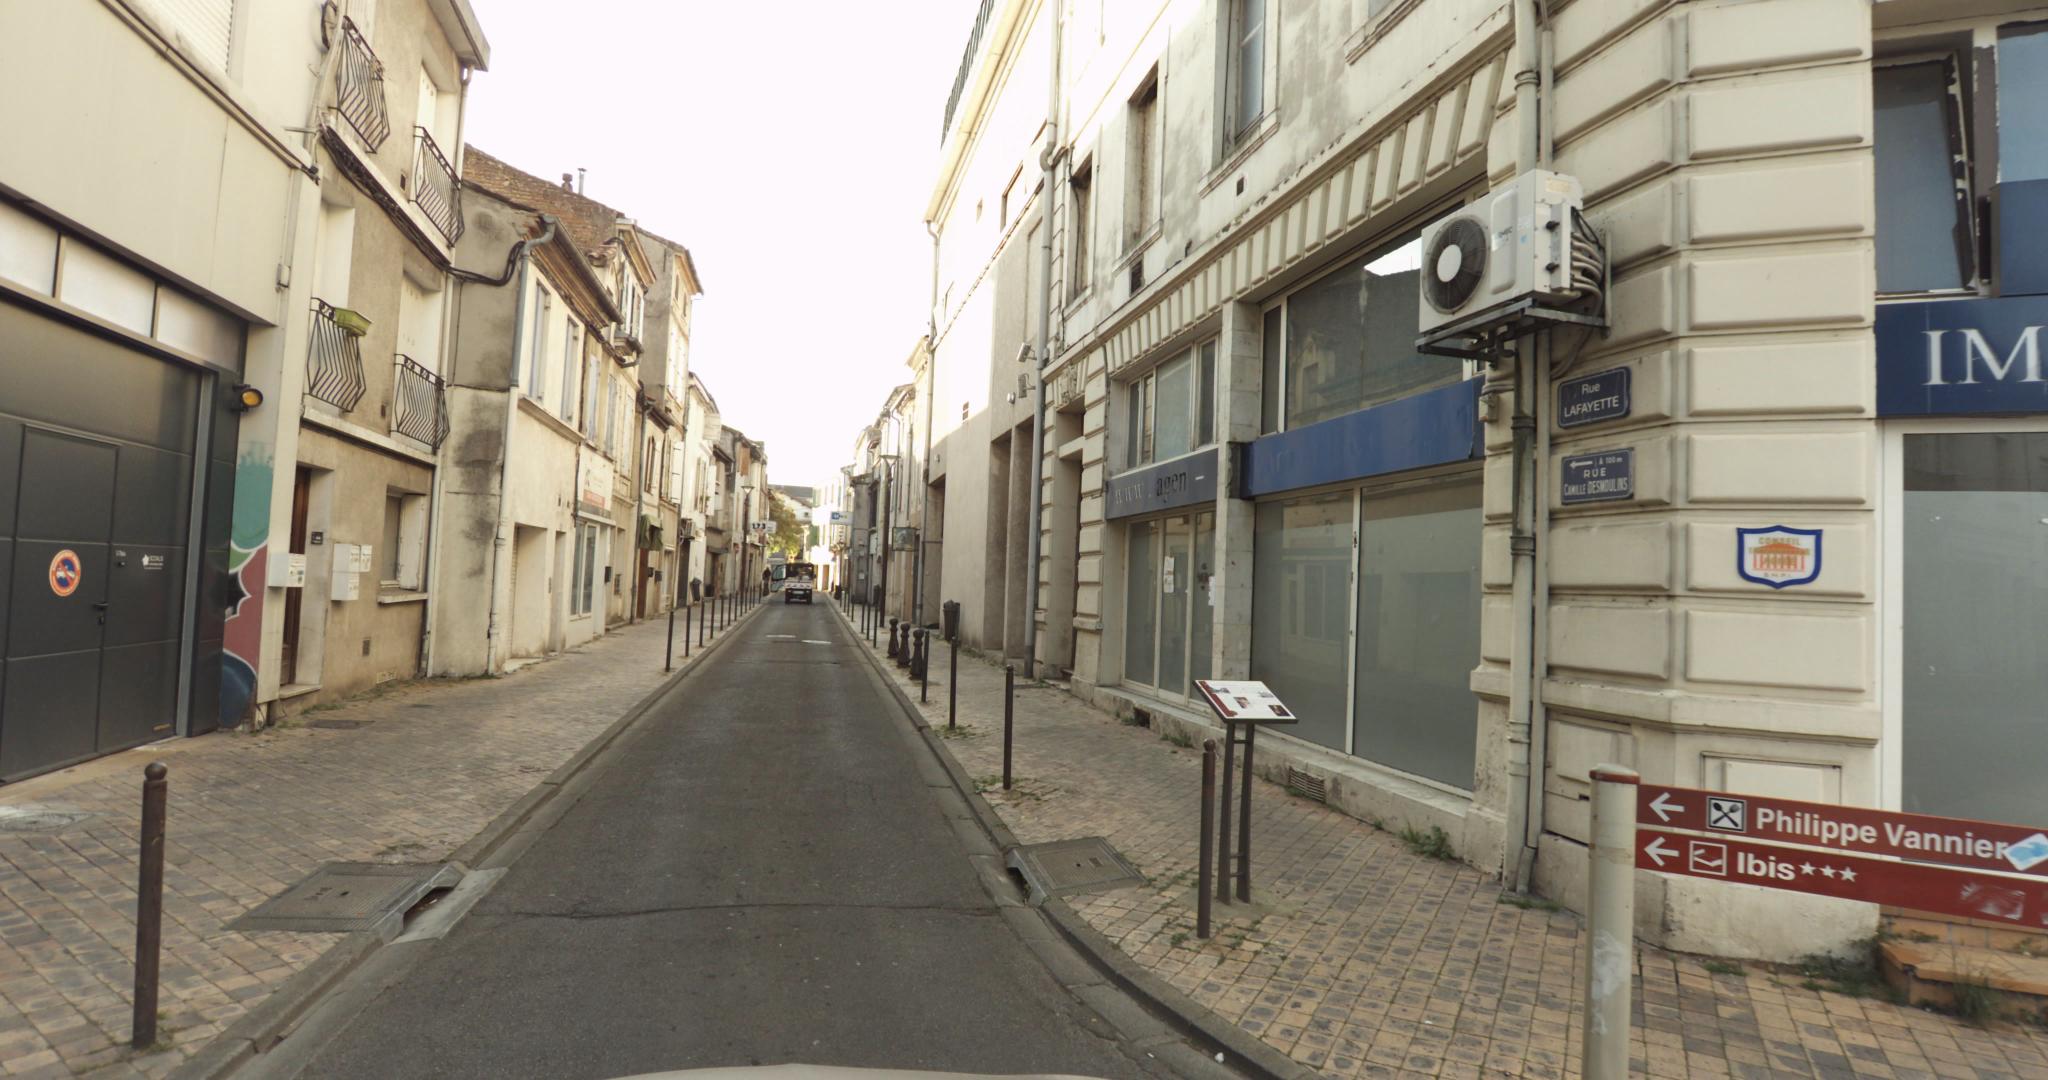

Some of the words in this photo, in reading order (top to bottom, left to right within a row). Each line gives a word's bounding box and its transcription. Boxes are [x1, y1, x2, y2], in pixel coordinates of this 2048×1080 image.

[1921, 325, 2047, 385] IM
[1581, 383, 1600, 394] Rue
[1563, 396, 1619, 417] LAFAYETTE
[1583, 467, 1607, 479] RUE
[1587, 477, 1628, 494] DESMOULINS
[1756, 807, 1878, 846] Philippe
[1884, 822, 2008, 860] Vannier
[1736, 851, 1796, 881] Ibis
